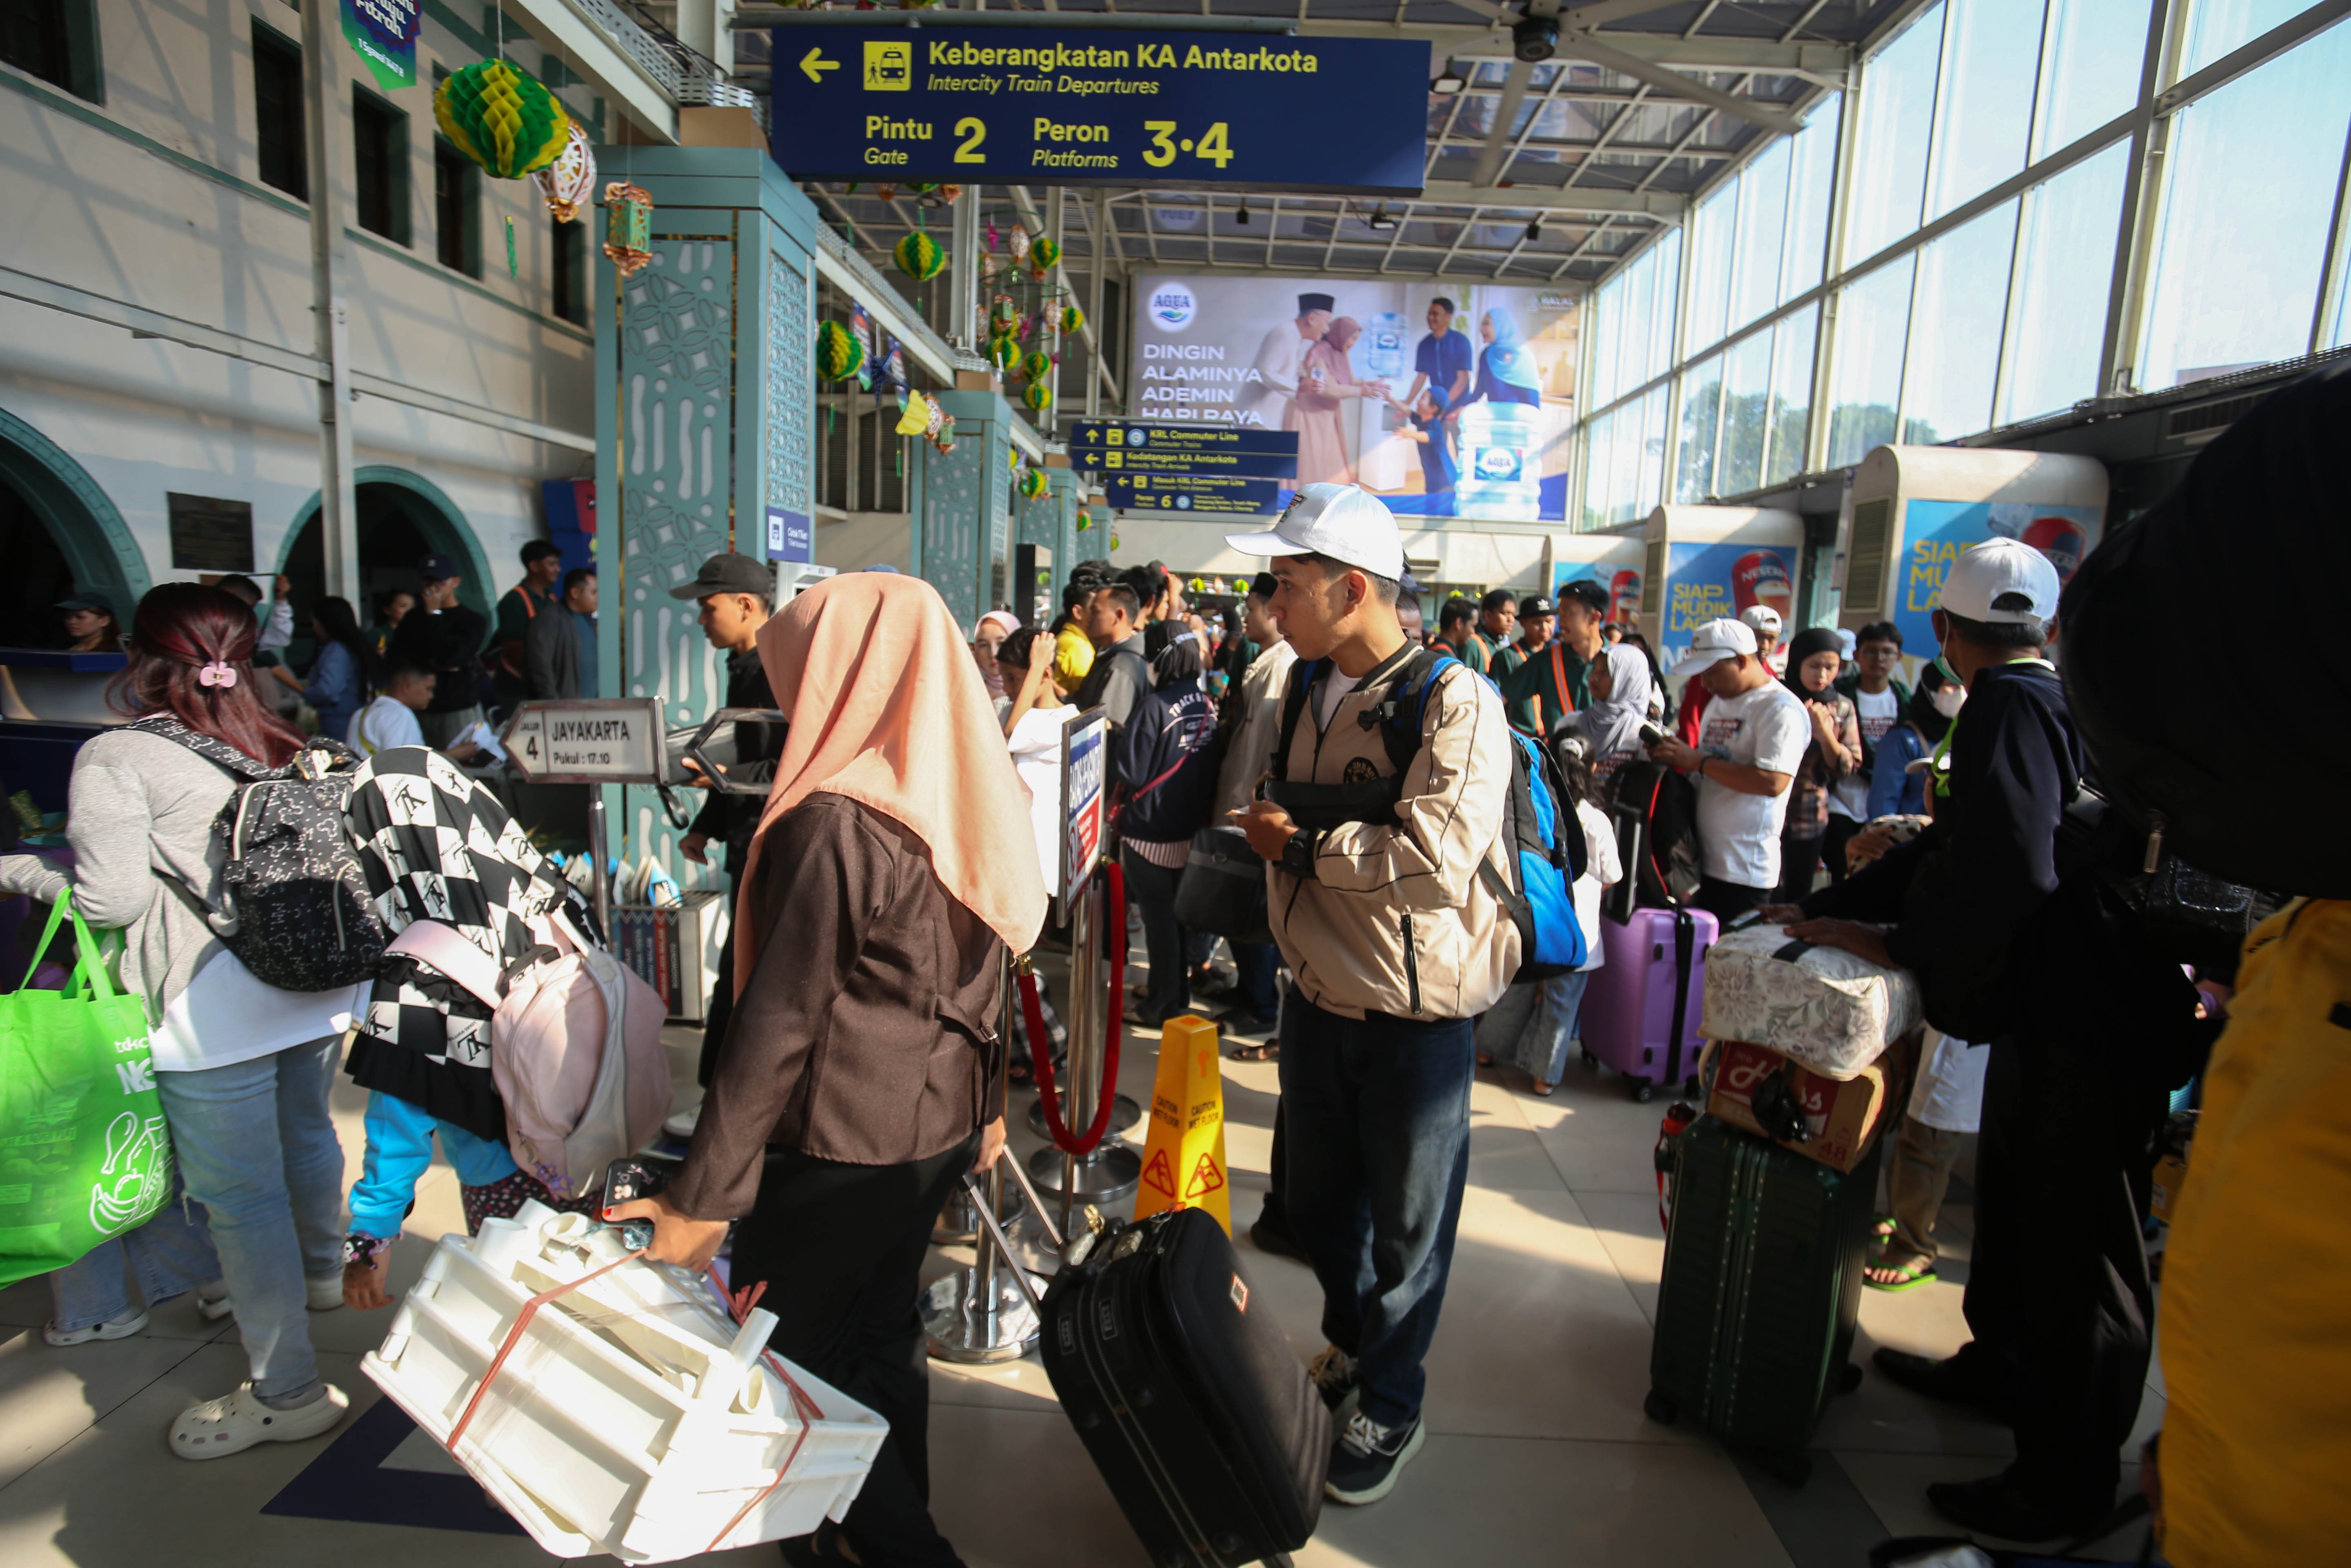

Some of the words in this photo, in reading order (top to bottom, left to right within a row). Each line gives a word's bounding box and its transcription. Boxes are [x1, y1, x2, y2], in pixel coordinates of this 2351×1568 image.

[929, 41, 1129, 73] Keberangkatan
[1137, 44, 1177, 69] KA
[1183, 45, 1318, 73] Antarkota
[927, 74, 1002, 95] Intercity
[1006, 74, 1052, 93] Train
[1057, 75, 1159, 97] Departures
[1034, 117, 1109, 142] Peron
[866, 116, 933, 140] Pintu
[954, 116, 987, 164] 2
[864, 147, 909, 165] Gate
[1032, 149, 1119, 169] Platforms
[1153, 294, 1190, 309] AQUA
[1143, 343, 1225, 360] DINGIN
[1141, 365, 1263, 383] ALAMINYA
[1141, 386, 1235, 403] ADEMIN
[1150, 429, 1169, 439] KRL
[1169, 430, 1218, 441] Commuter
[1219, 432, 1240, 441] Line
[1126, 451, 1178, 463] Kedatangan
[1179, 453, 1193, 462] KA
[1194, 454, 1239, 465] Antarkota
[1161, 494, 1172, 509] 6
[1674, 583, 1724, 599] SIAP
[1672, 599, 1731, 617] MUDIK
[1169, 693, 1195, 717] TRACK
[520, 723, 539, 731] JALUR
[551, 720, 631, 742] JAYAKARTA
[526, 736, 538, 761] 4
[553, 752, 579, 765] Pukul
[587, 753, 610, 765] 17.10
[1156, 1095, 1178, 1115] CAUTION
[1191, 1100, 1216, 1117] CAUTION
[1153, 1107, 1164, 1120] WET
[1164, 1112, 1179, 1129] FLOOR
[1188, 1118, 1200, 1130] WET
[1201, 1112, 1219, 1126] FLOOR
